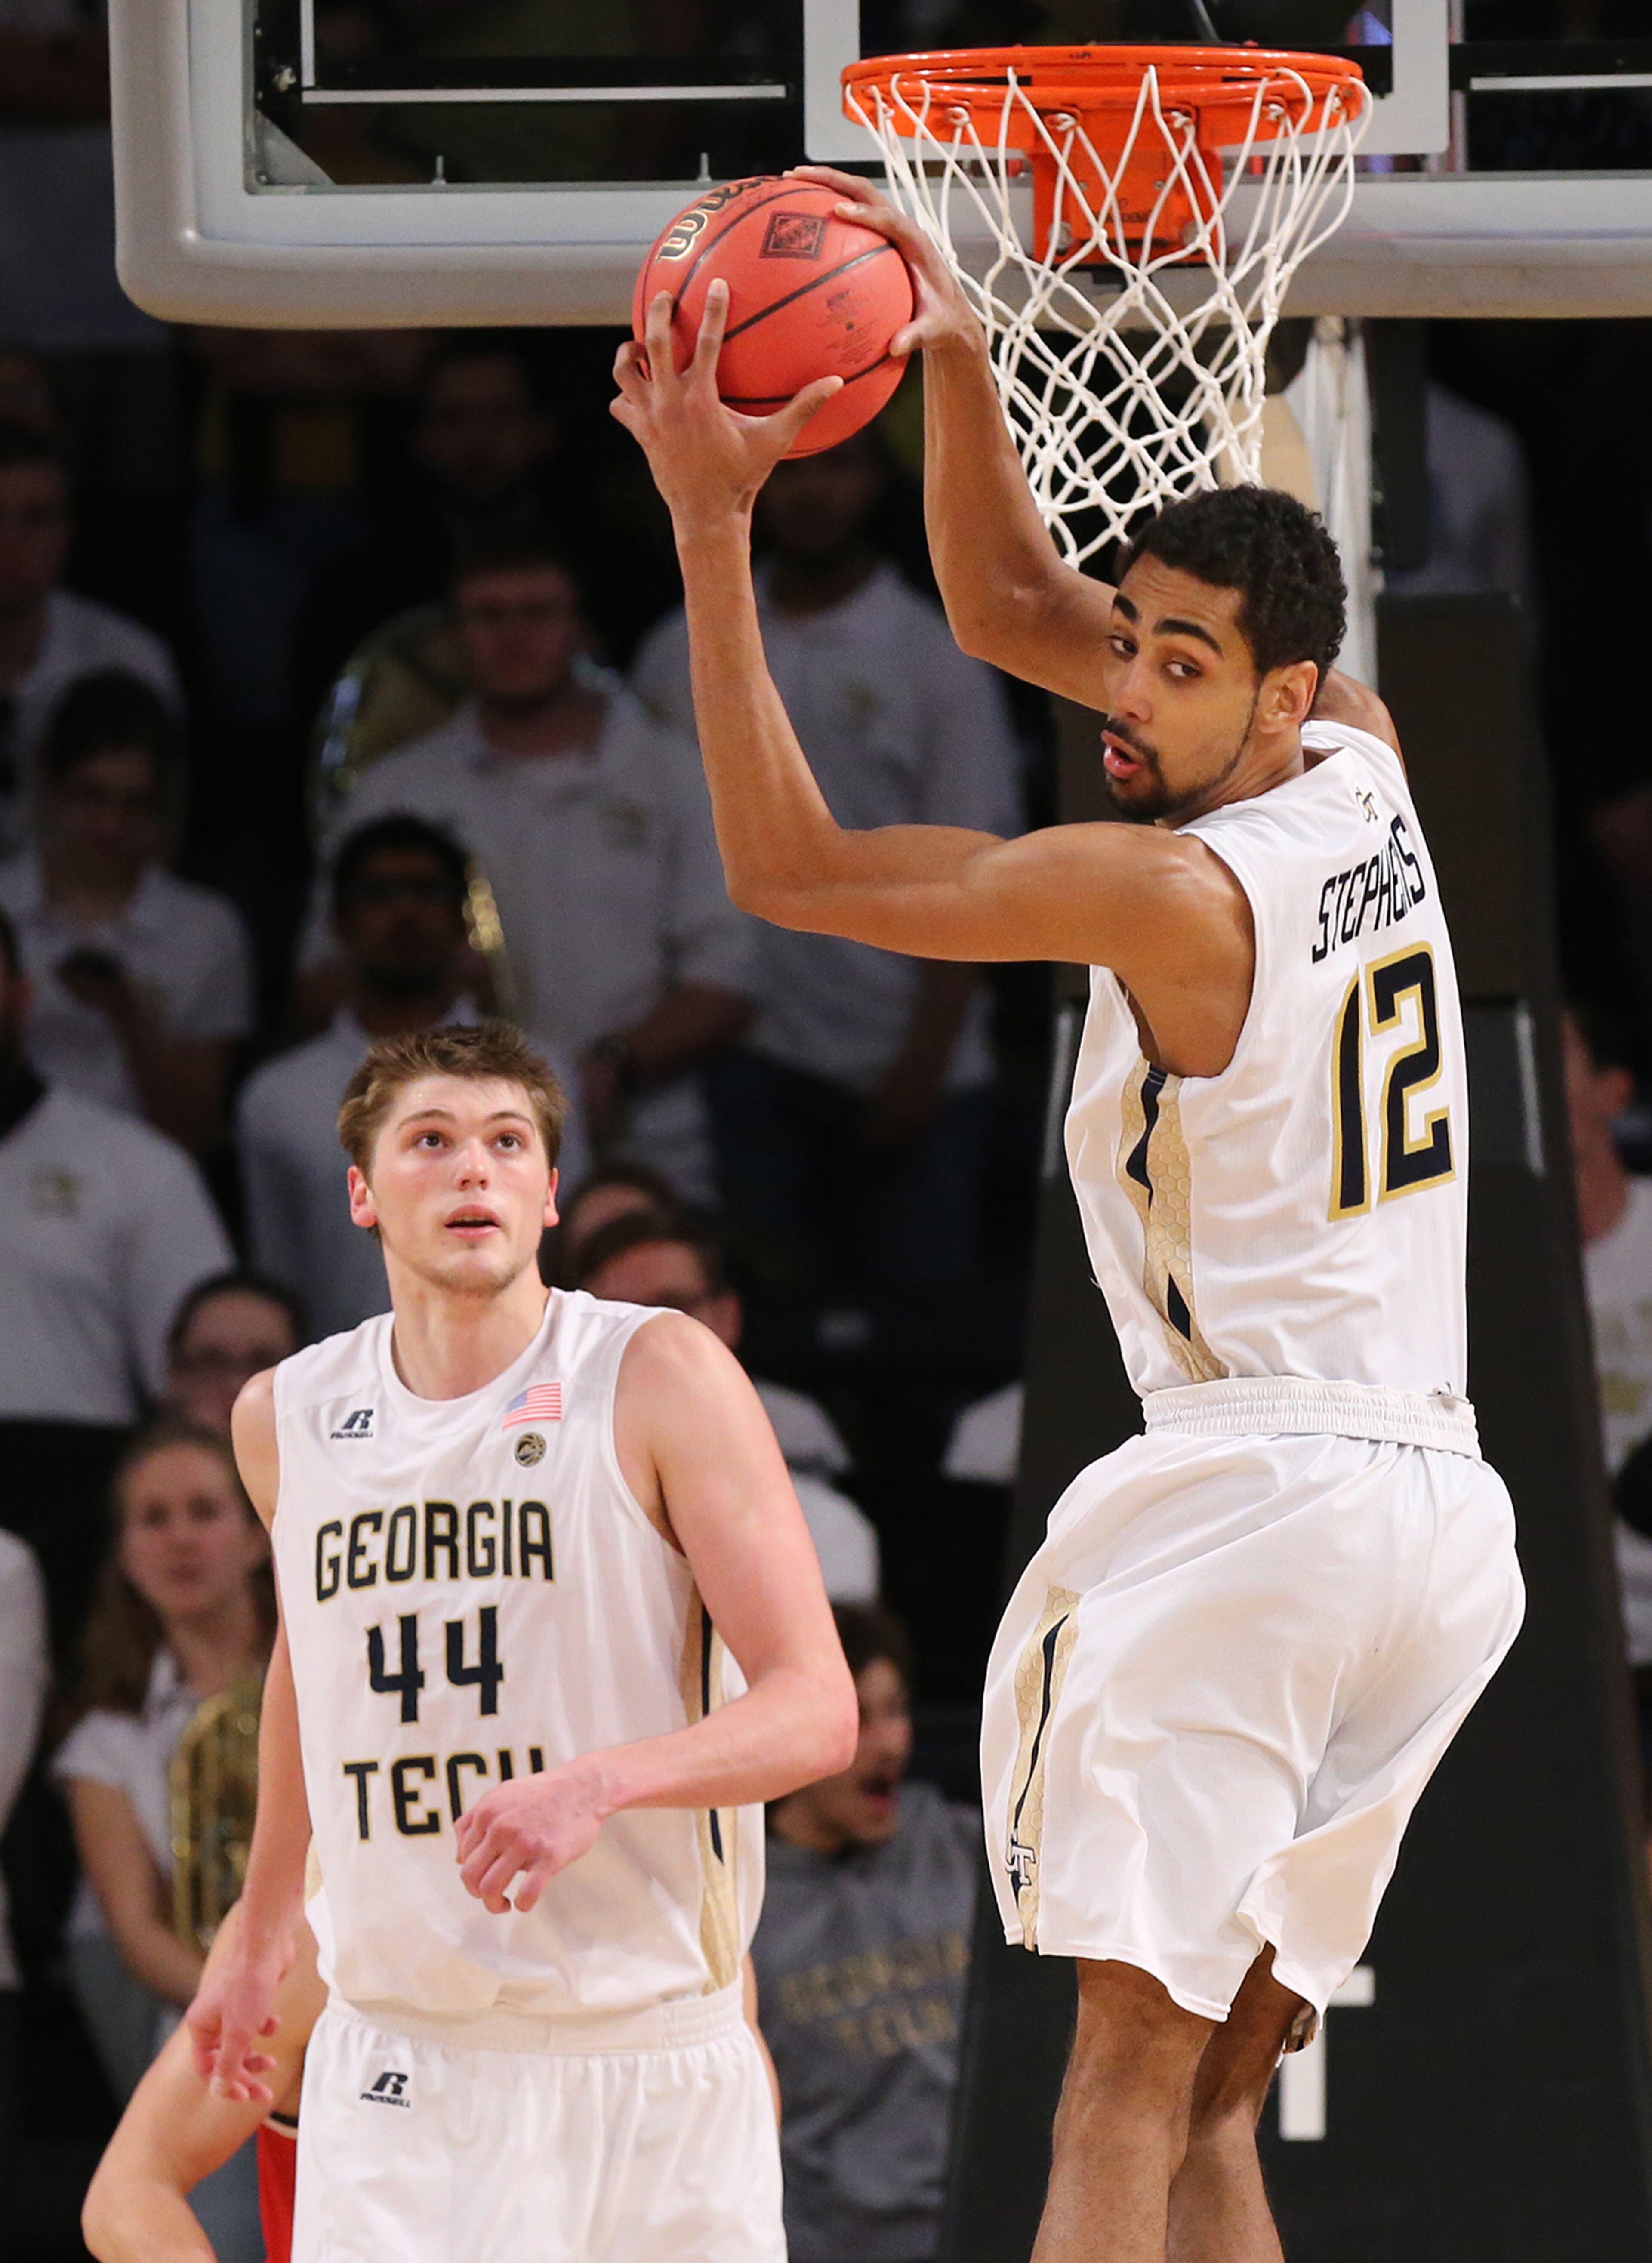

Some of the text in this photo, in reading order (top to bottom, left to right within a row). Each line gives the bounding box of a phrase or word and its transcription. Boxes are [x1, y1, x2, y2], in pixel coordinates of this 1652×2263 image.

[1328, 940, 1456, 1222] 12
[315, 1498, 557, 1604] GEORGIA
[365, 1605, 505, 1724] 44
